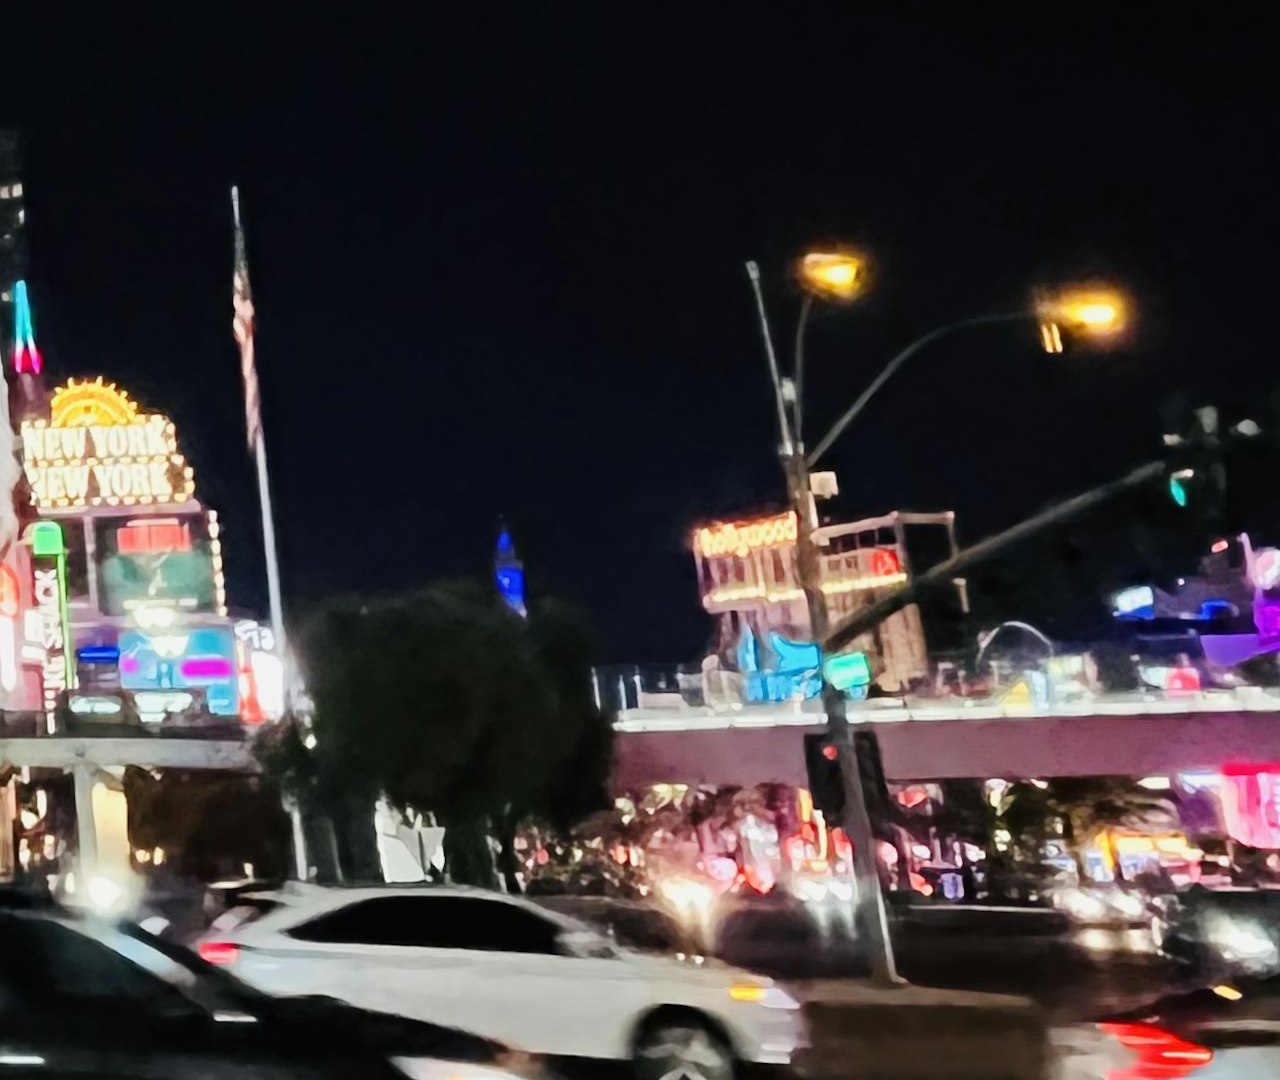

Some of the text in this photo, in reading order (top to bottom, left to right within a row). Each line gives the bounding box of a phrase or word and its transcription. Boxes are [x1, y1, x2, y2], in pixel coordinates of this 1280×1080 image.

[22, 420, 169, 460] NEW YORK
[24, 461, 173, 500] NEW YORK
[700, 510, 798, 558] hollywood
